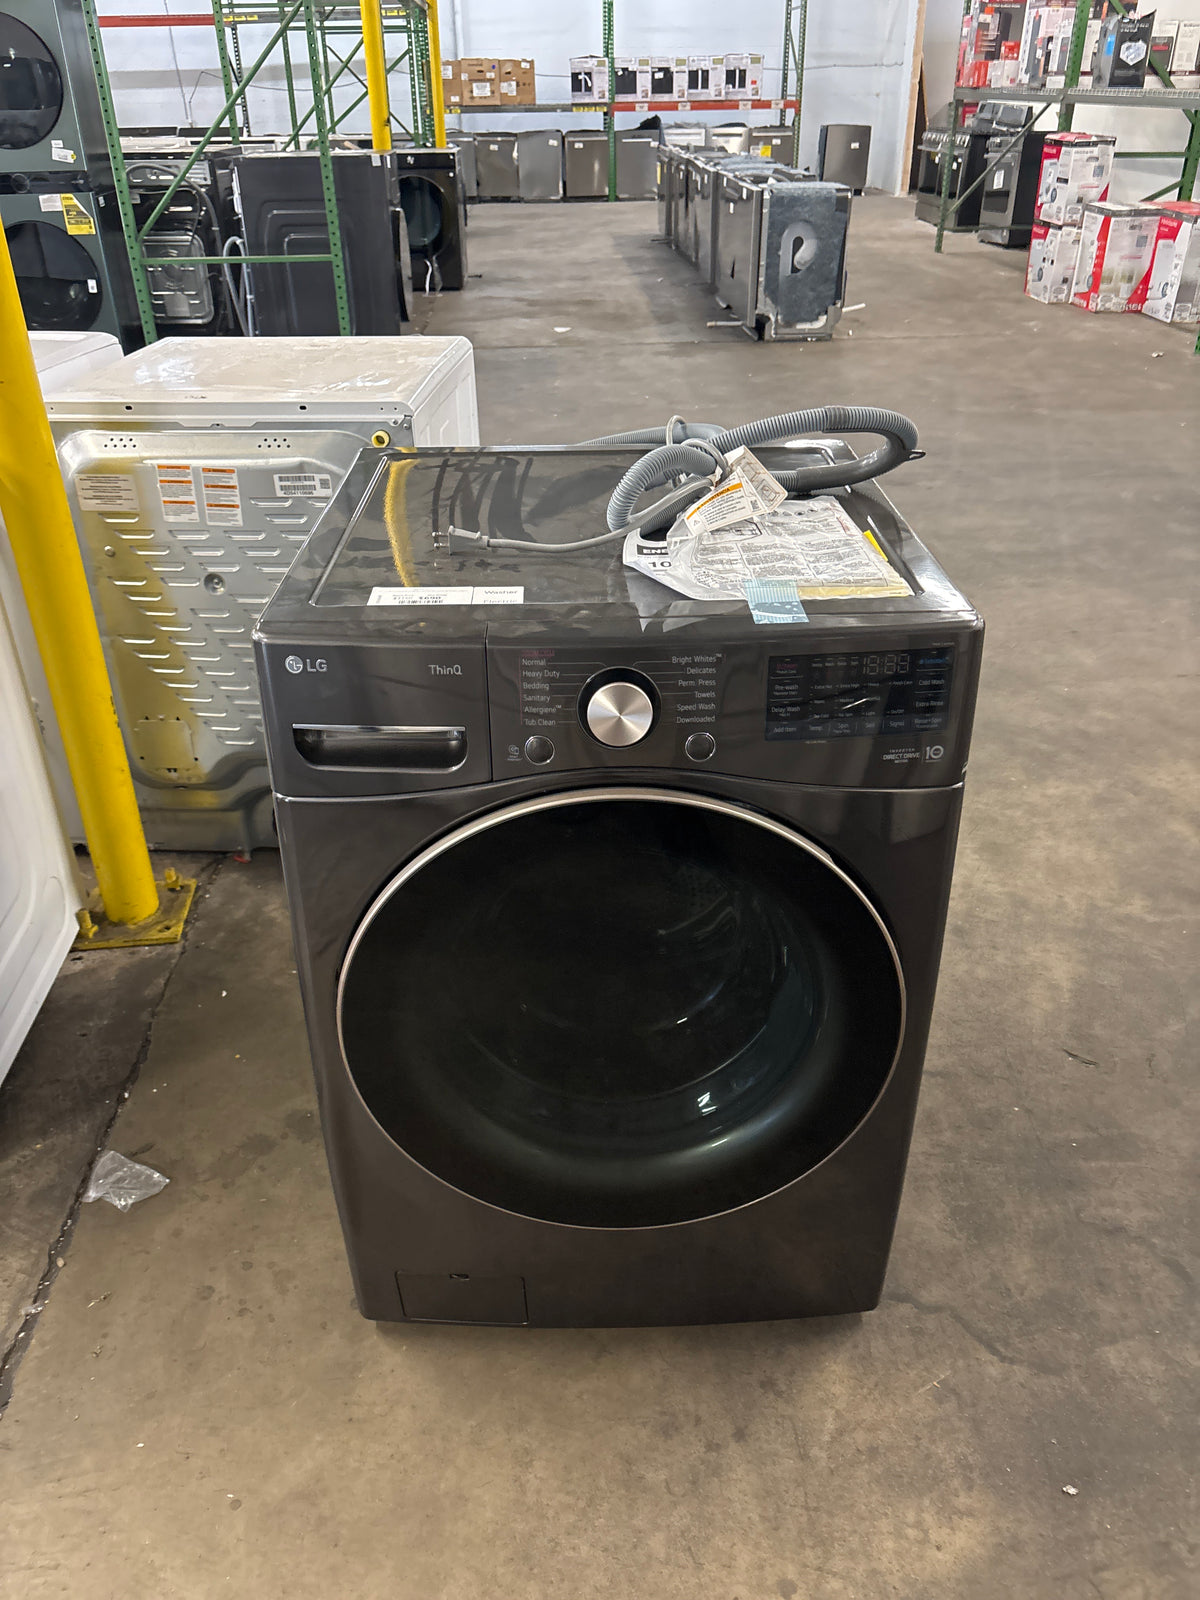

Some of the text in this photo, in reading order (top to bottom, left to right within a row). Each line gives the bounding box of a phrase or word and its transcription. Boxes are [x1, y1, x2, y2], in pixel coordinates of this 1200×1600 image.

[306, 658, 328, 672] LG
[522, 658, 546, 666] Normal
[671, 656, 692, 665] Bright
[427, 664, 463, 676] ThinQ
[522, 669, 560, 679] Heavy Duty
[523, 682, 550, 690] Bedding
[523, 694, 551, 703] Sanitary
[677, 702, 716, 711] Speed Wash
[676, 715, 716, 724] Downloaded
